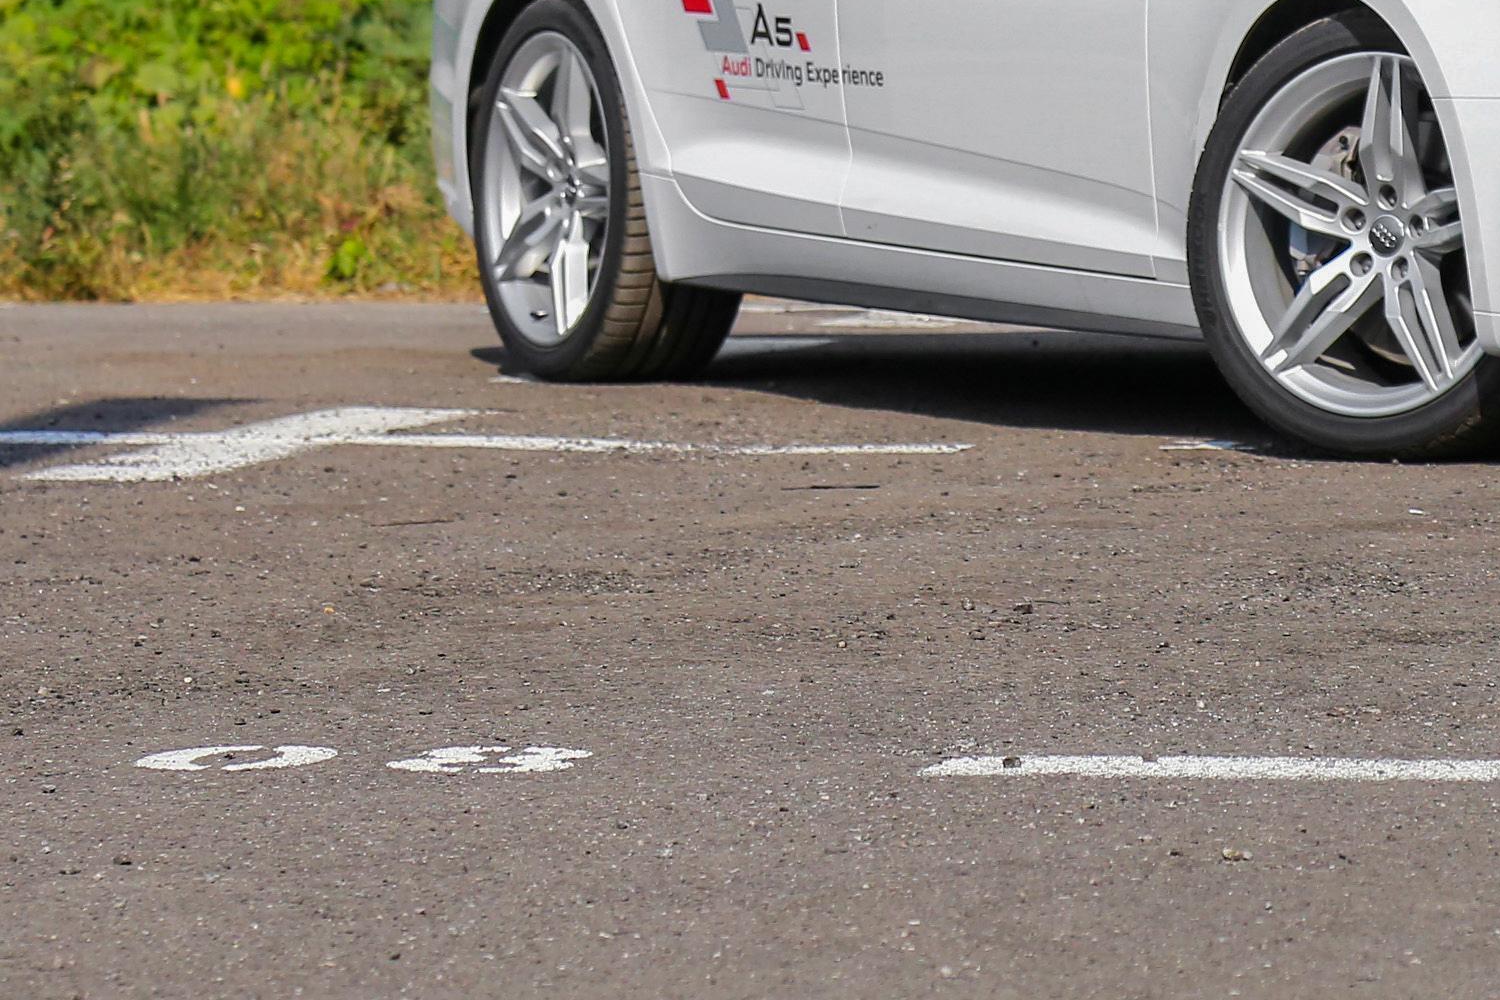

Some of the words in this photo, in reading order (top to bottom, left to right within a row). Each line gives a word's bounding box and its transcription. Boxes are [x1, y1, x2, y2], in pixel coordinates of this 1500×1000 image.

[750, 2, 793, 47] A5
[722, 56, 752, 76] Audi
[755, 58, 803, 86] Driving
[806, 61, 884, 87] Experience
